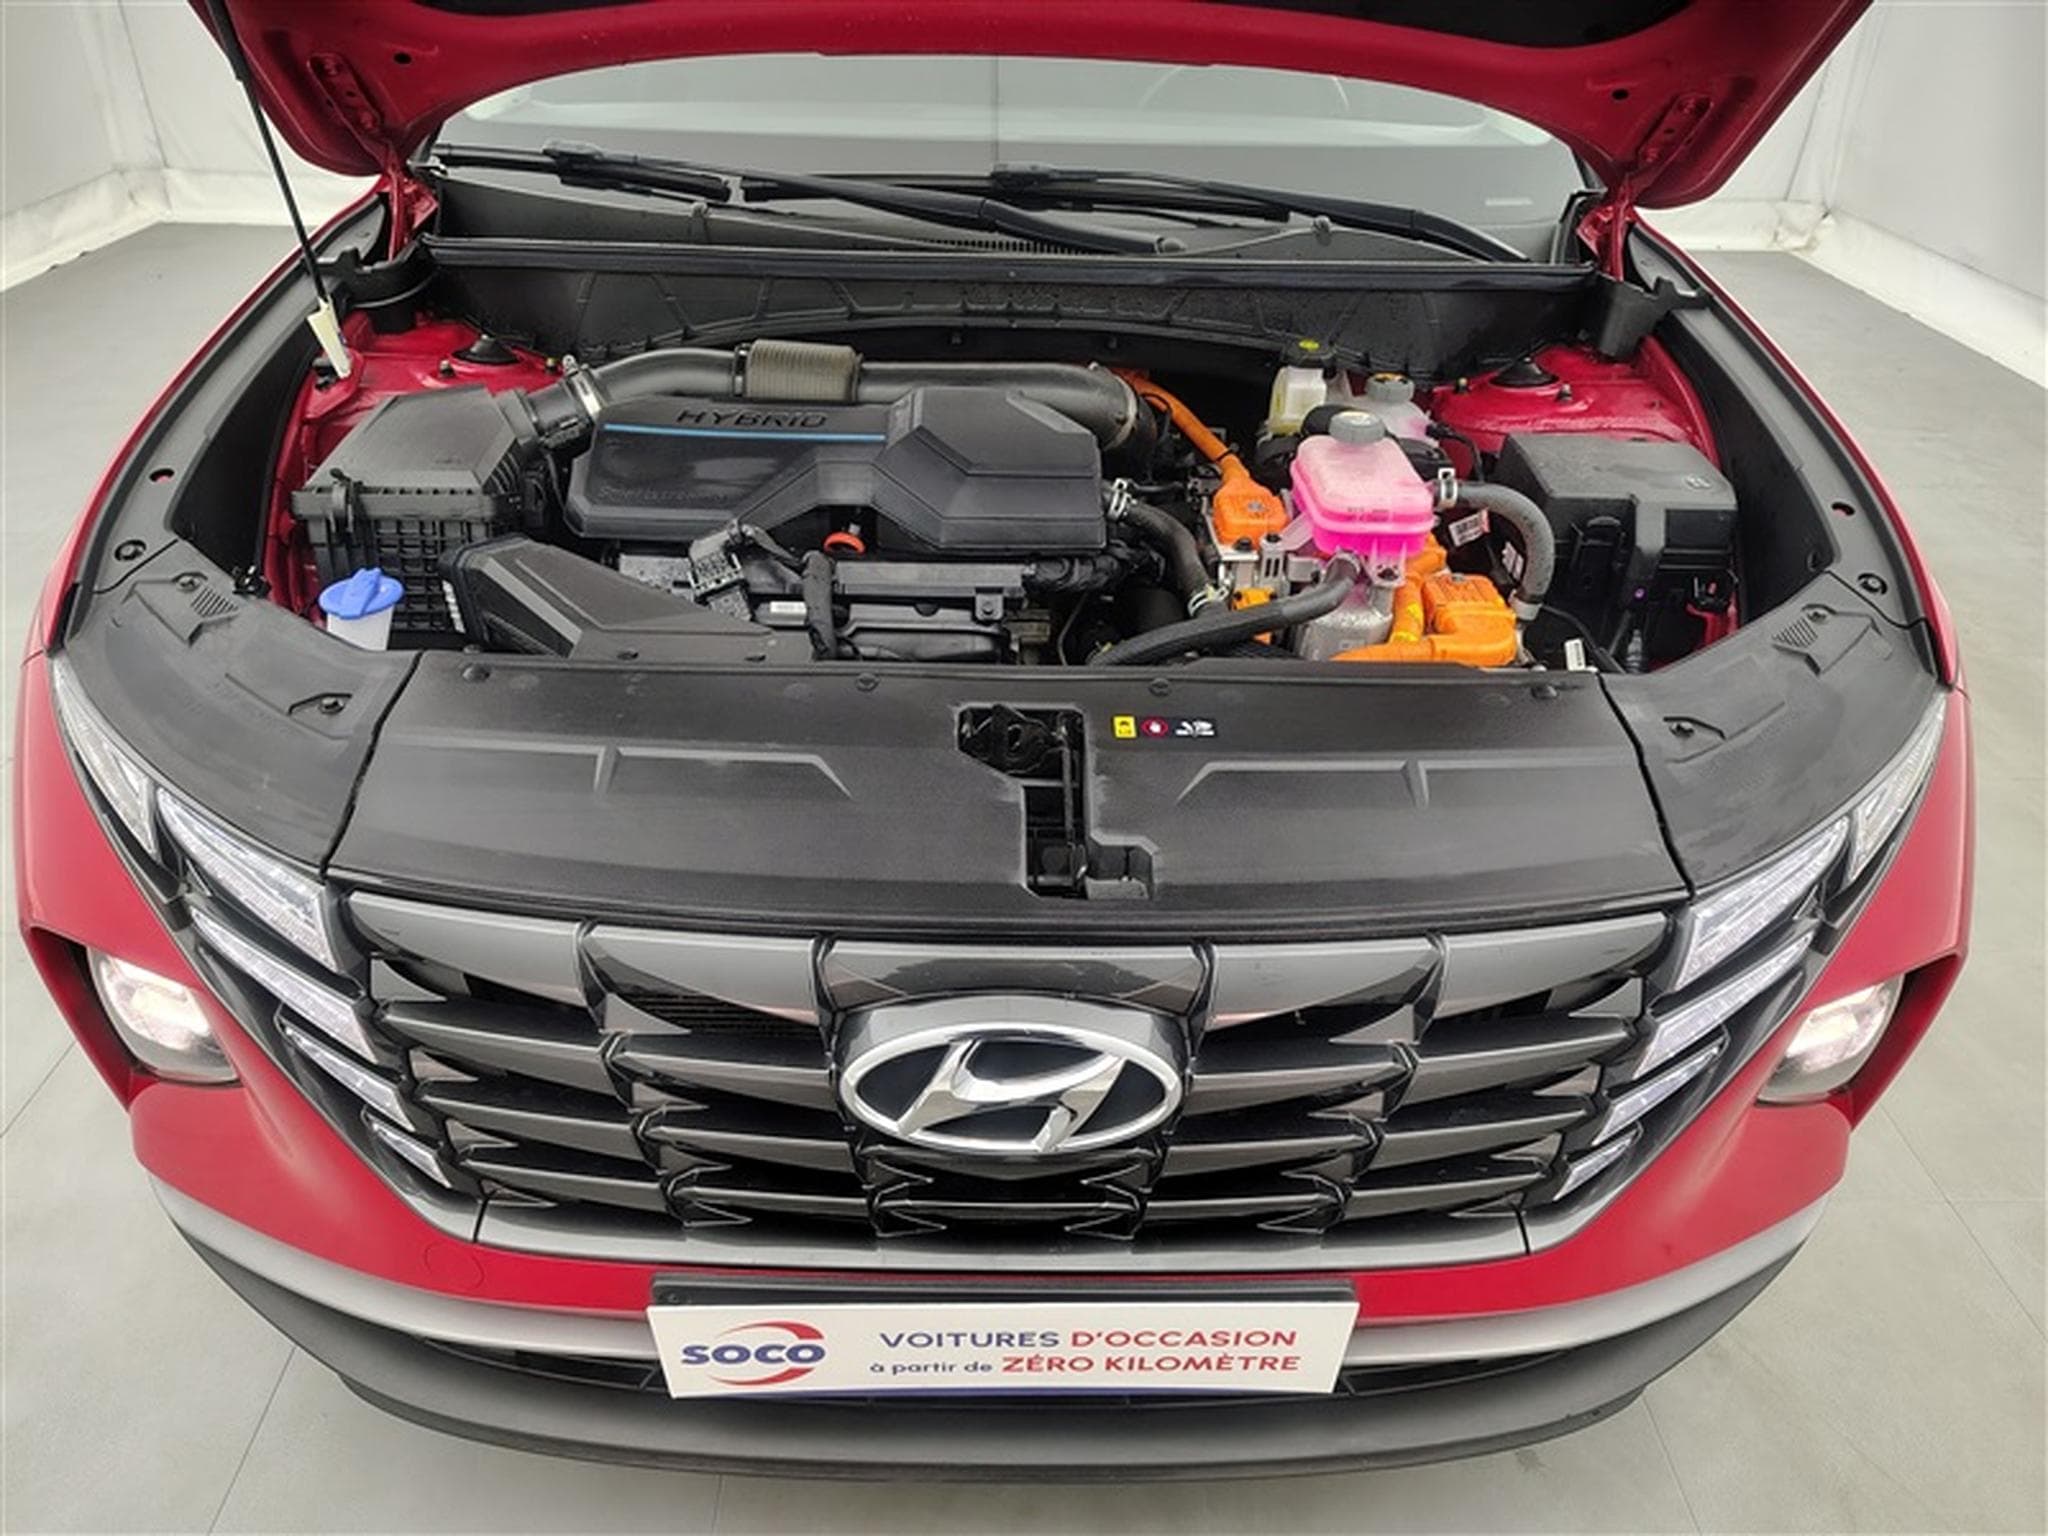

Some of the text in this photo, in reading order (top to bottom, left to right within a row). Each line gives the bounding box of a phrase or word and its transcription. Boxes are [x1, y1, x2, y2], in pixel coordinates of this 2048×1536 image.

[676, 408, 827, 428] HYBRID
[879, 1330, 1297, 1349] VOITURES D'OCCASION
[681, 1343, 826, 1365] SOCO
[869, 1352, 1301, 1376] à partir de ZÉRO KILOMÈTRE
